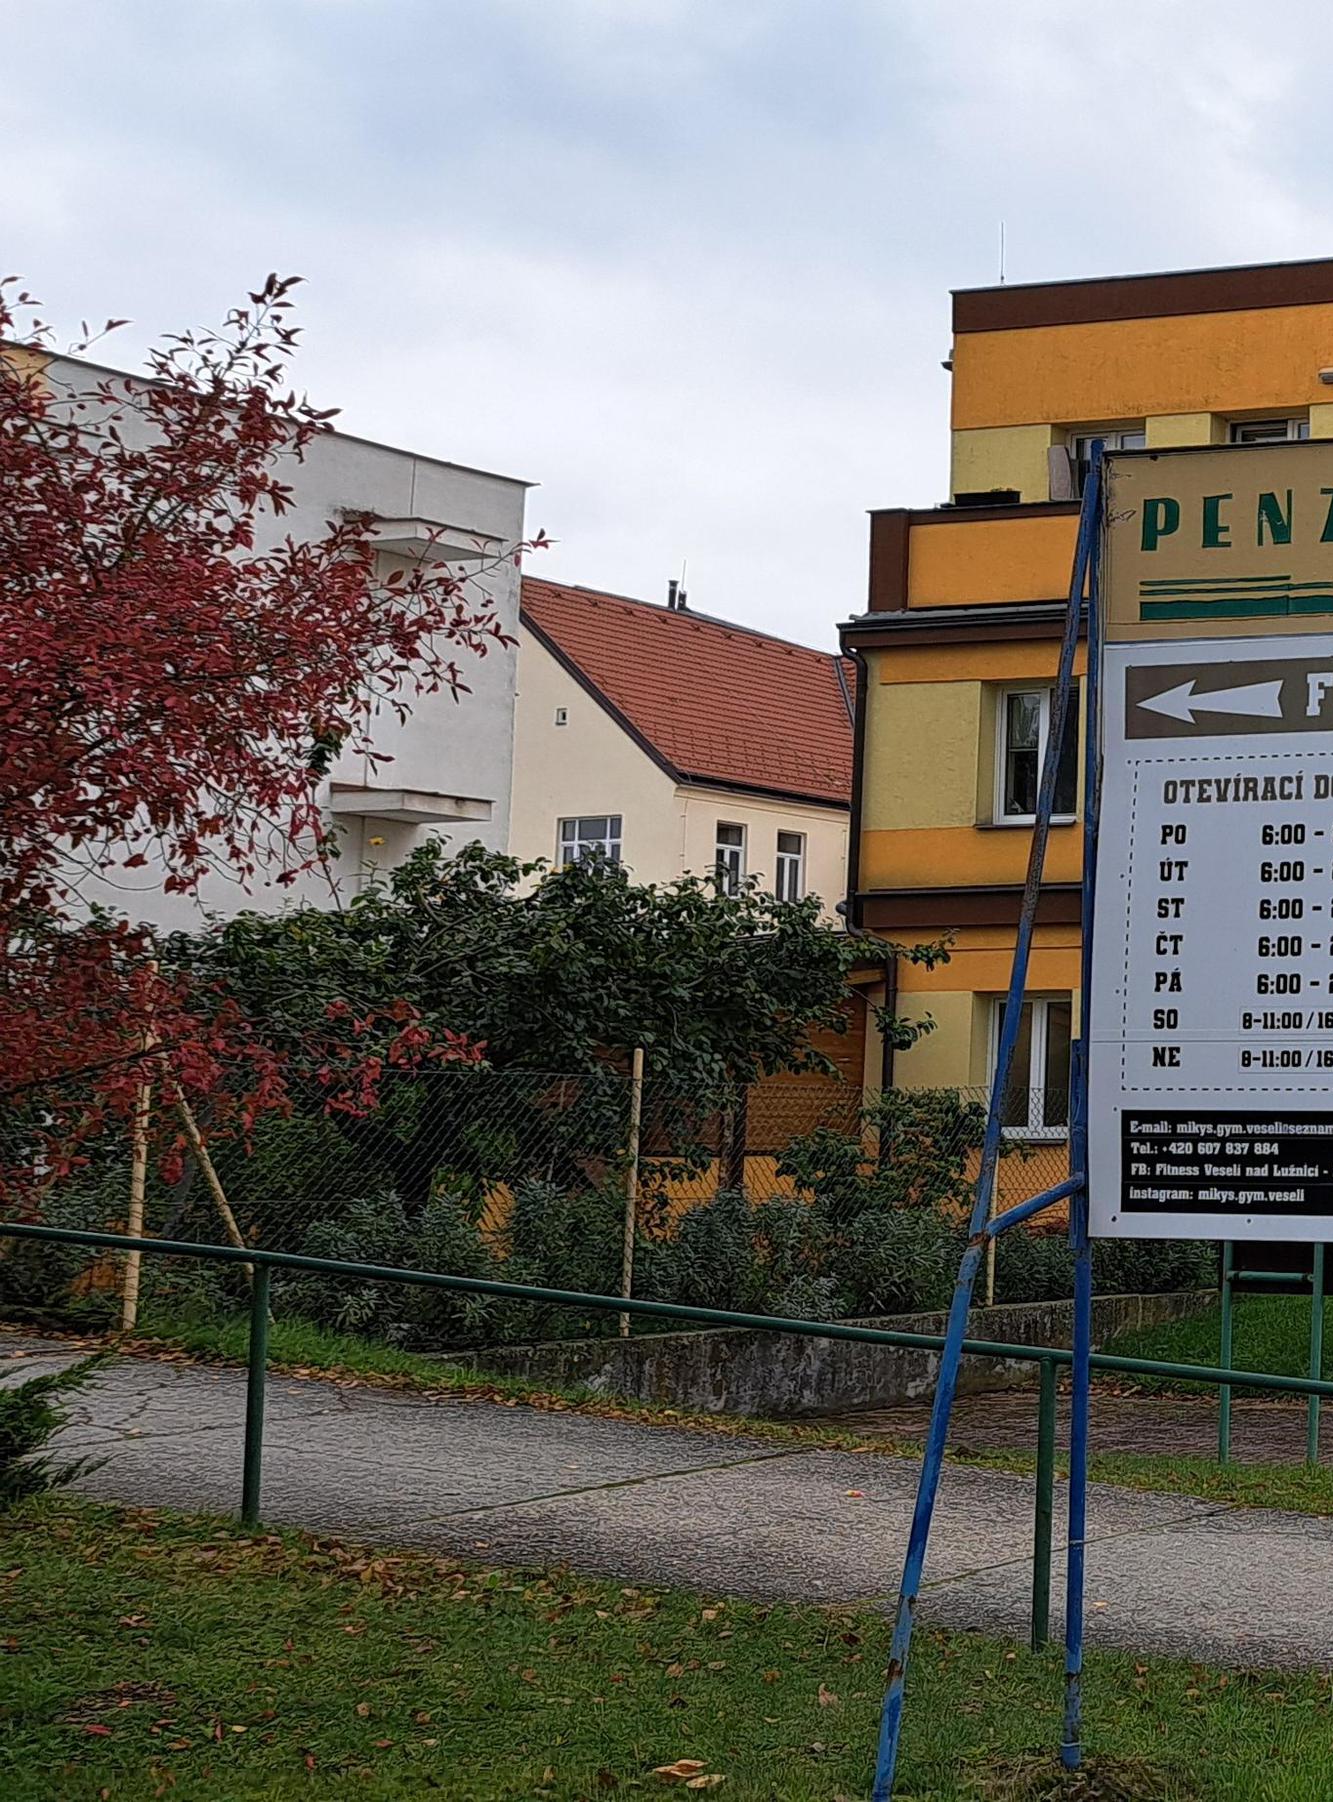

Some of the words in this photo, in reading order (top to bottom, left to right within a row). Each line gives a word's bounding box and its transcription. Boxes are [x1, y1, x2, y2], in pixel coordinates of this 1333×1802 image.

[1163, 770, 1304, 805] OTEVÍRACÍ
[1160, 824, 1187, 845] PO
[1261, 823, 1306, 846] 6:00
[1159, 857, 1189, 882] ÚT
[1260, 860, 1305, 883] 6:00
[1157, 897, 1185, 919] ST
[1259, 898, 1304, 920] 6:00
[1155, 931, 1184, 956] ČT
[1258, 935, 1303, 958] 6:00
[1154, 967, 1183, 993] PÁ
[1257, 973, 1301, 995] 6:00
[1153, 1008, 1178, 1030] SO
[1152, 1046, 1181, 1068] NE
[1129, 1120, 1172, 1134] E-mail:
[1130, 1141, 1158, 1155] Tel.:
[1162, 1141, 1194, 1155] +420
[1197, 1142, 1222, 1155] 607
[1225, 1142, 1250, 1155] 837
[1253, 1142, 1279, 1155] 884
[1130, 1162, 1151, 1176] FB:
[1155, 1163, 1200, 1176] Fitness
[1245, 1163, 1269, 1177] nad
[1128, 1185, 1195, 1204] instagram:
